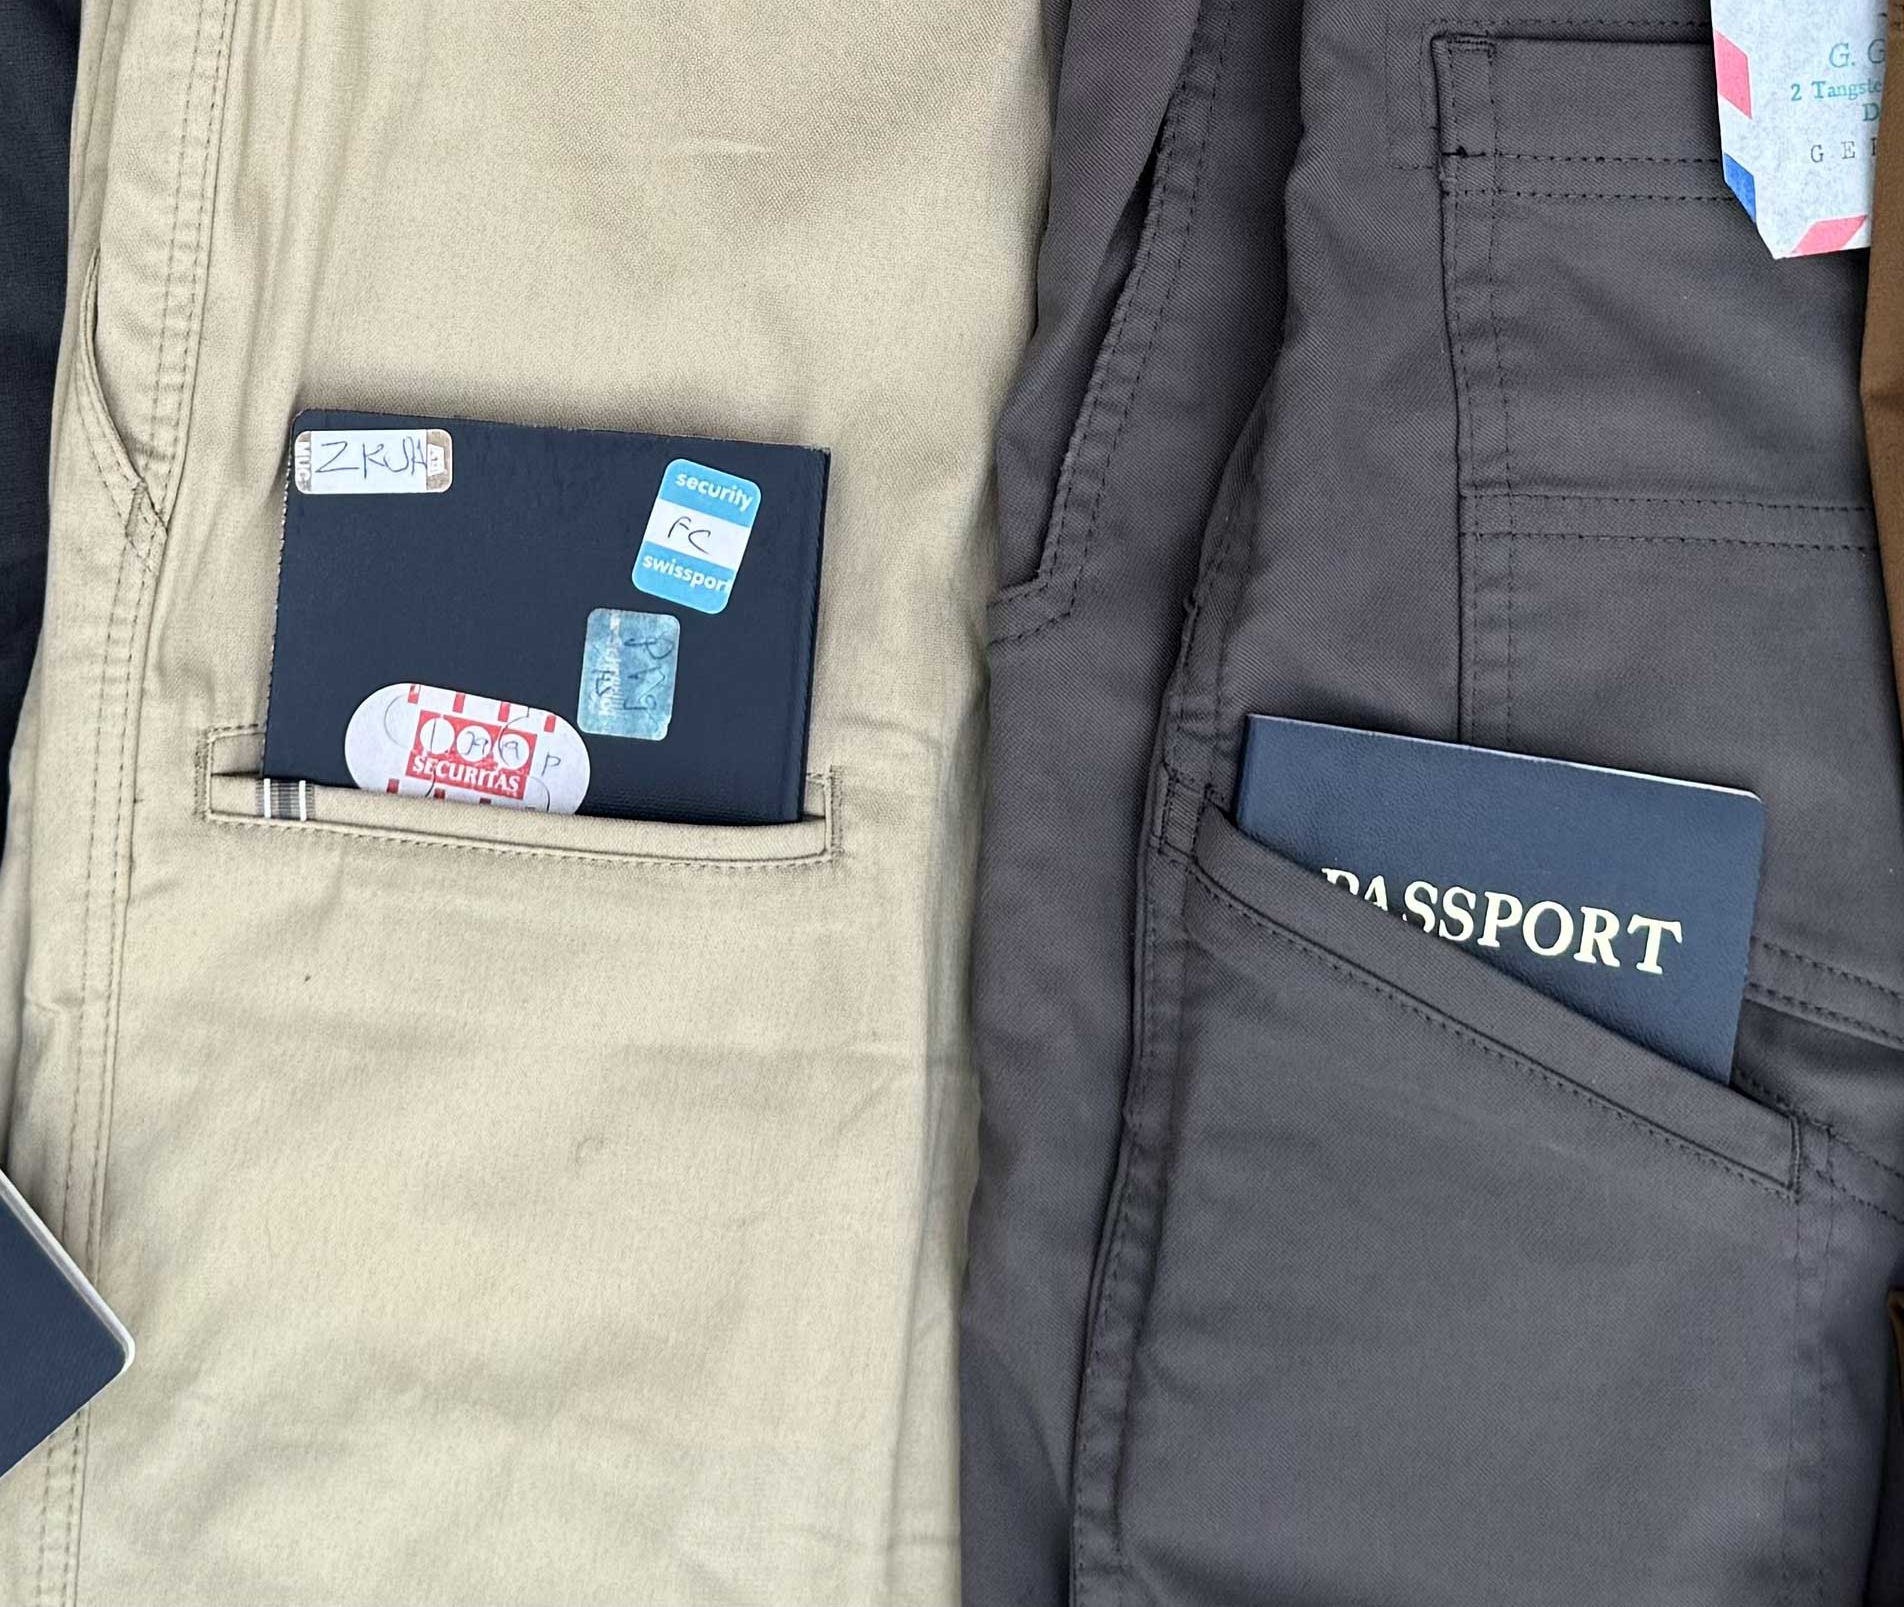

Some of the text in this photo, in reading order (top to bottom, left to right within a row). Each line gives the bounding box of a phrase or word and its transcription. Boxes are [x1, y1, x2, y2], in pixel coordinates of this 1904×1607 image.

[1790, 83, 1803, 102] 2
[675, 472, 753, 513] security
[411, 755, 521, 794] SECURITAS
